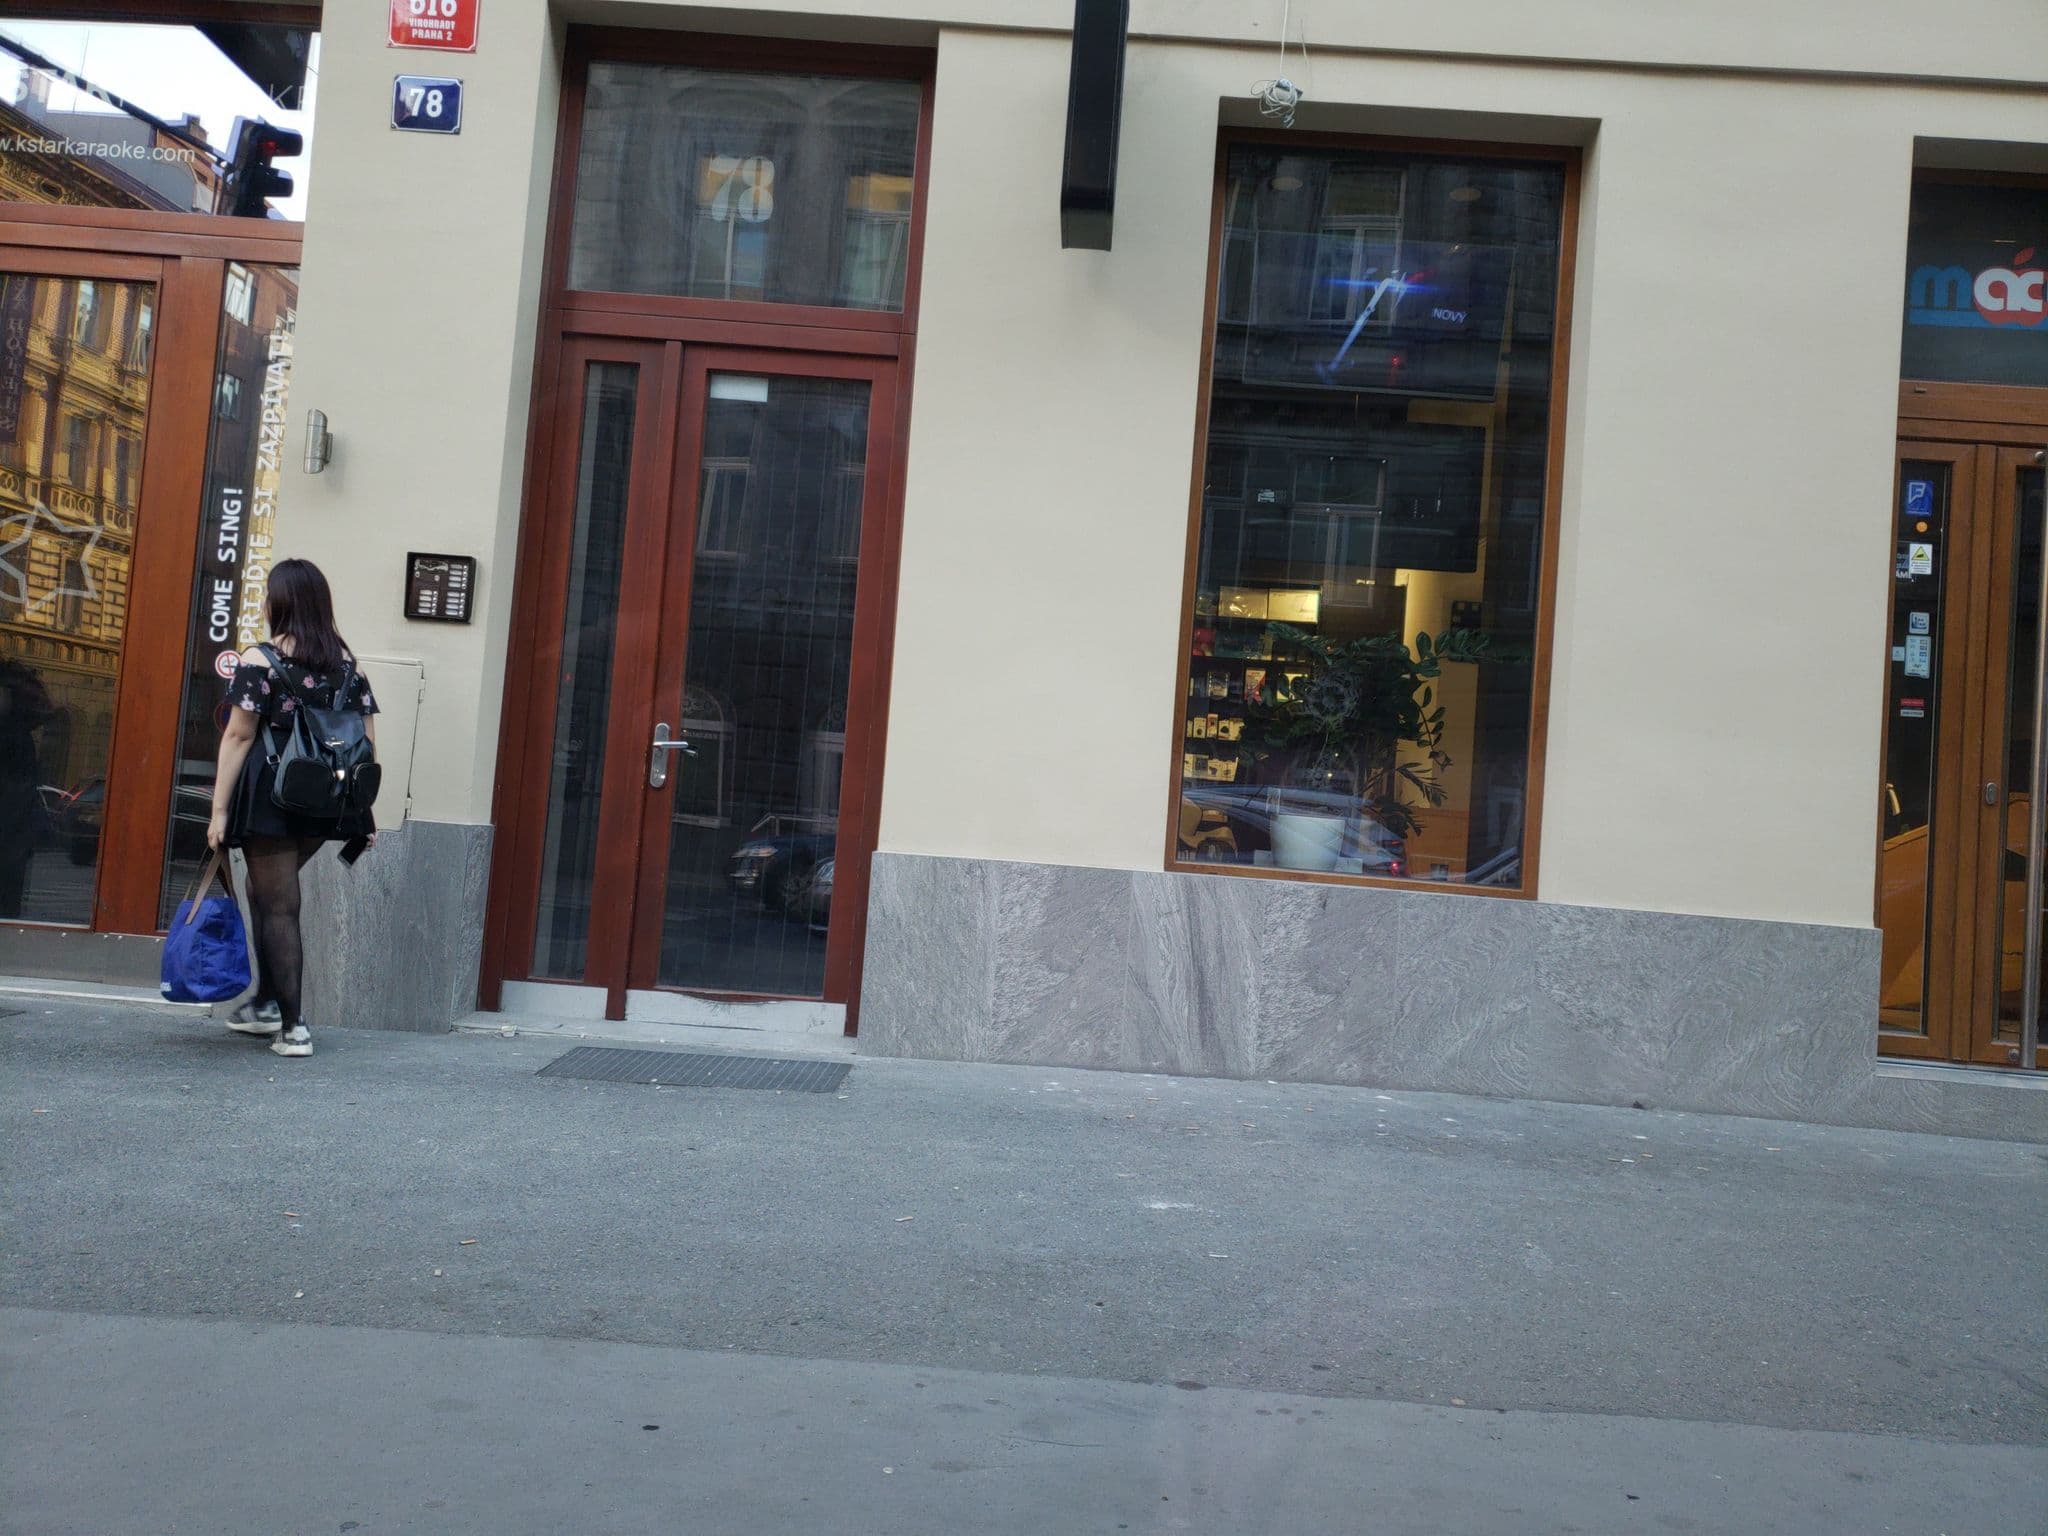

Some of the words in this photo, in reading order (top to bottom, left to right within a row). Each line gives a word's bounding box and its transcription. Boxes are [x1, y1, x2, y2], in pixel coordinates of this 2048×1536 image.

[412, 28, 443, 41] PRAHA
[446, 31, 453, 41] 2
[409, 88, 443, 118] 78
[708, 154, 775, 223] 78
[218, 487, 243, 564] SING!
[237, 534, 269, 644] PŘIJĎTE
[253, 486, 273, 518] SI
[209, 579, 233, 643] COME
